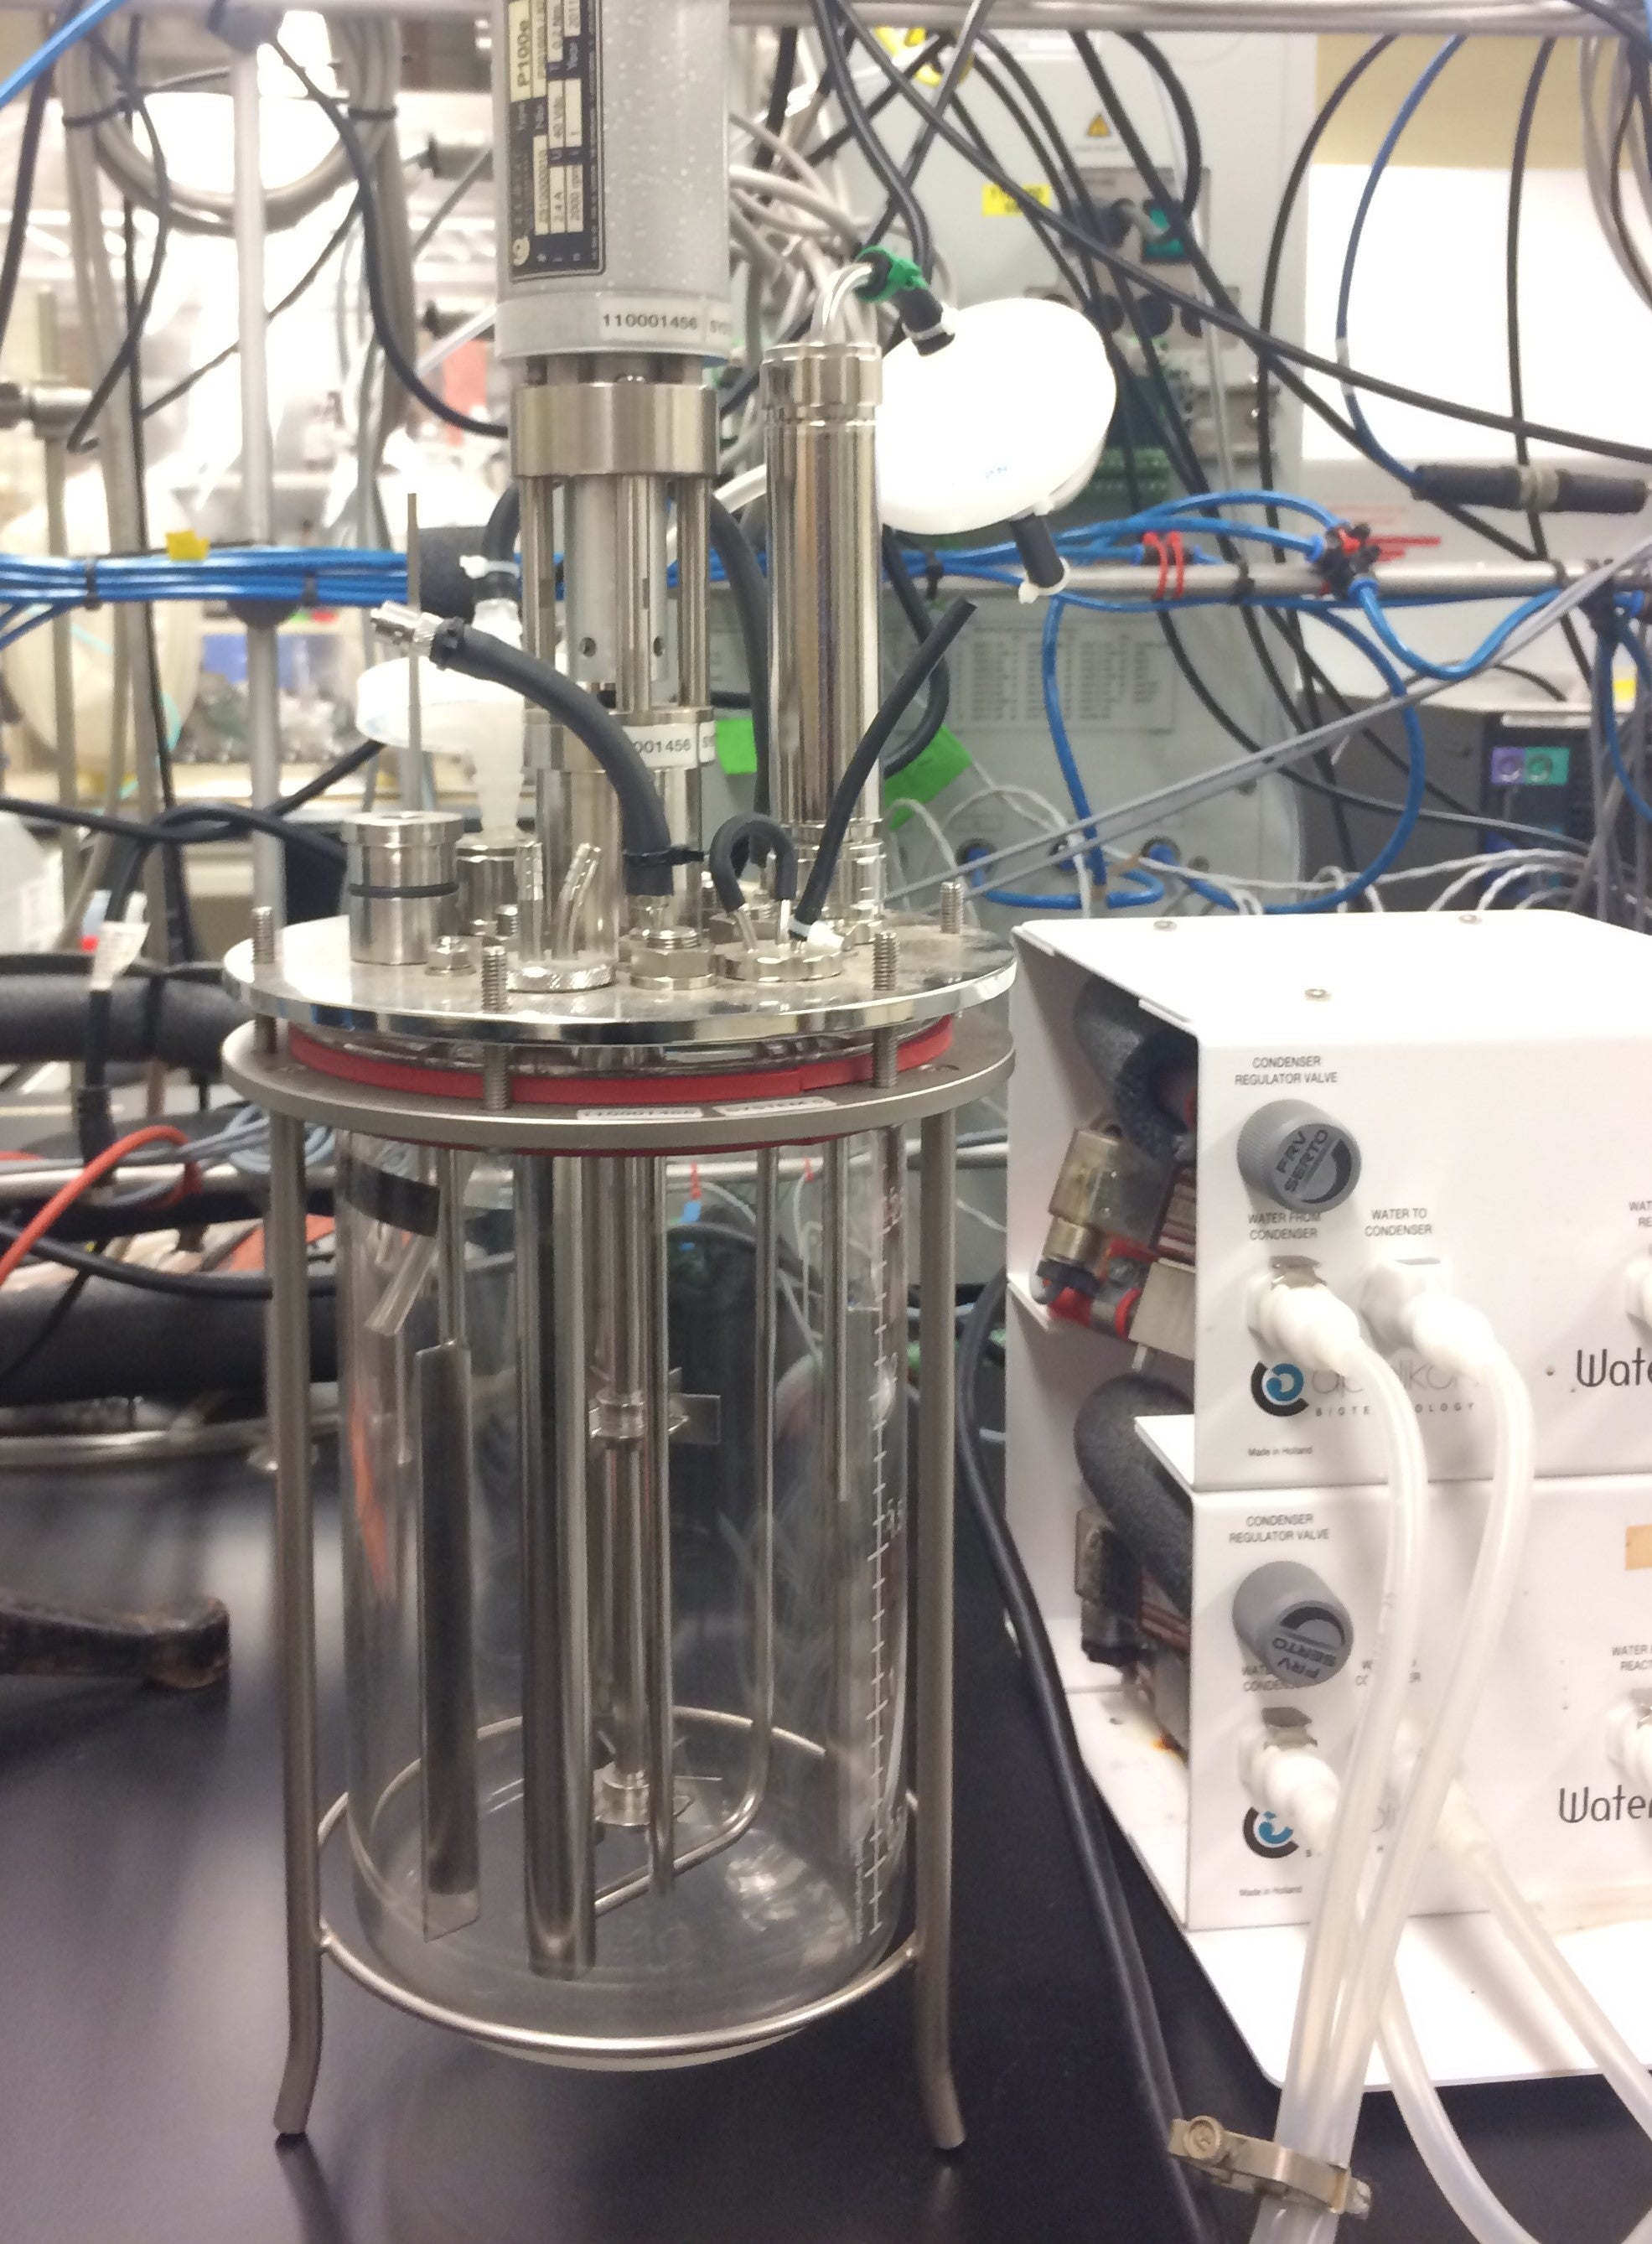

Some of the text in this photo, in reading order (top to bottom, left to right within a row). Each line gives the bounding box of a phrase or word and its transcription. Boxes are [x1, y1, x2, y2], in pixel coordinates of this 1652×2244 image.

[1252, 1056, 1321, 1068] CONDENSER
[1235, 1072, 1337, 1085] REGULATOR VALVE
[1276, 1131, 1306, 1174] FRV
[1284, 1129, 1328, 1193] SERTO
[1372, 1208, 1427, 1220] WATER TO
[1250, 1228, 1318, 1240] CONDENSER
[1365, 1224, 1432, 1236] CONDENSER
[1577, 1347, 1652, 1387] Wat
[1246, 1513, 1313, 1526] CONDENSER
[1229, 1529, 1329, 1543] REGULATOR VALVE
[1612, 1645, 1648, 1656] WATER
